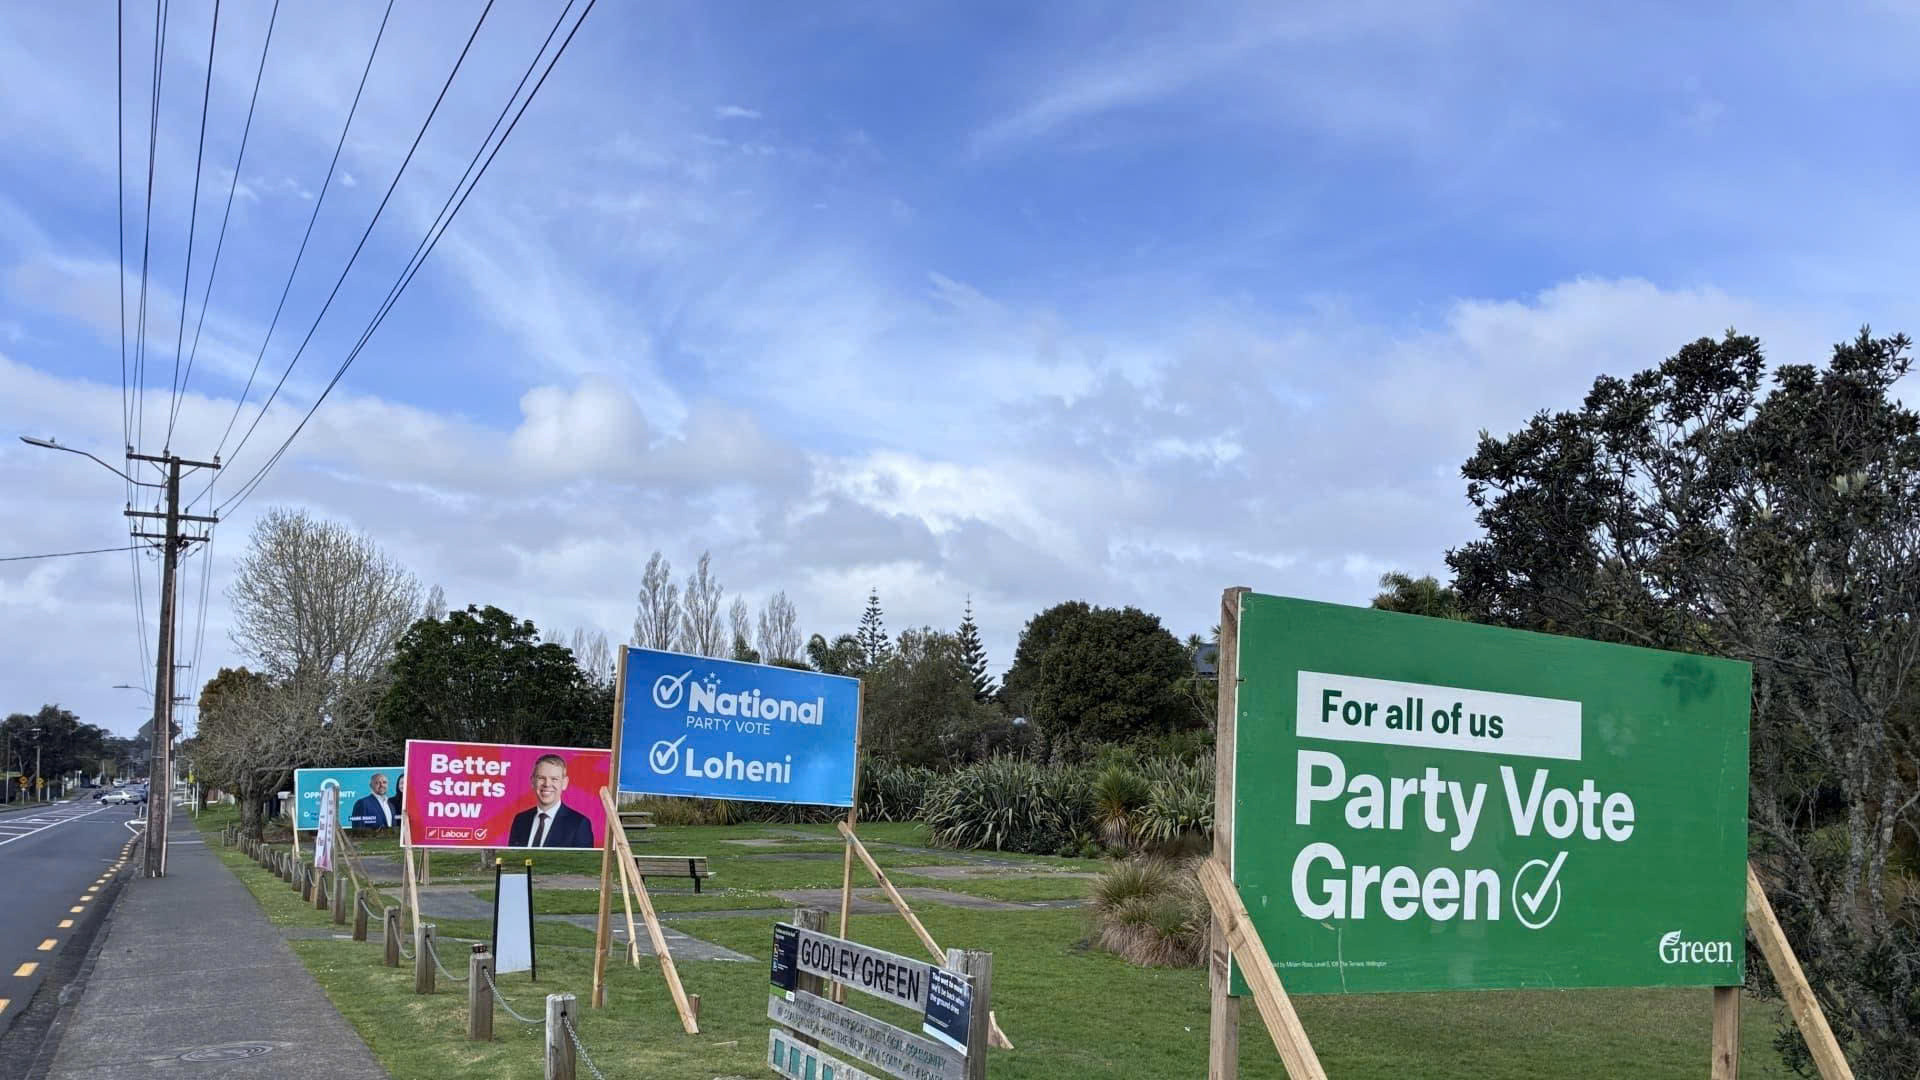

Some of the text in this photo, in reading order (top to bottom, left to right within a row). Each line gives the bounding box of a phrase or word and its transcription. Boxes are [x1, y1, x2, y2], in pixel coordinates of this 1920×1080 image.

[688, 681, 825, 726] National
[1321, 689, 1504, 739] For all of us
[686, 715, 771, 735] PARTY VOTE
[430, 753, 511, 776] Better
[685, 748, 792, 784] Loheni
[304, 790, 355, 799] OPPNITY
[428, 777, 506, 798] starts
[1295, 749, 1635, 852] Party Vote
[427, 801, 482, 818] now
[440, 829, 470, 839] Labour
[1291, 842, 1501, 921] Green
[1658, 929, 1733, 964] Green
[801, 938, 860, 981] GODLEY
[862, 956, 920, 1003] GREEN
